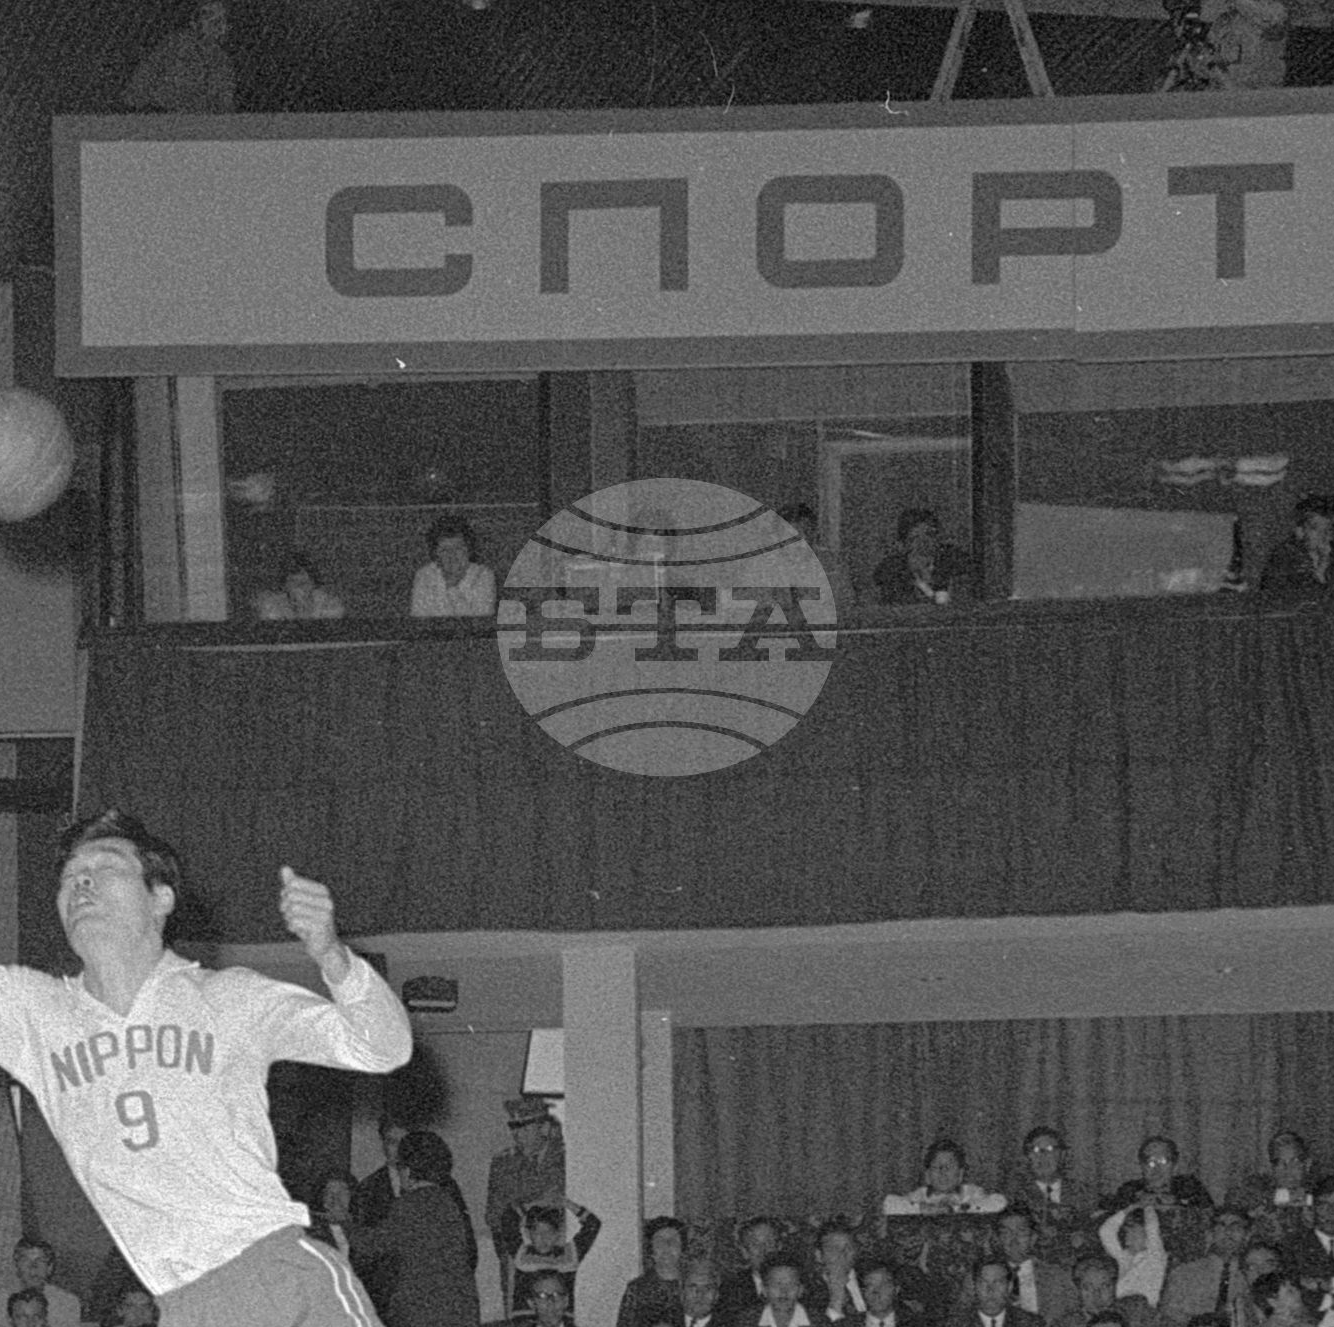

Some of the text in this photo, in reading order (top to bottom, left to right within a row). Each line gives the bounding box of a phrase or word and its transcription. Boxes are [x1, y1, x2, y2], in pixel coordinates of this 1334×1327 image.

[323, 160, 1296, 299] СПОРТ
[51, 1023, 215, 1092] NIPPON
[113, 1089, 161, 1153] 9
